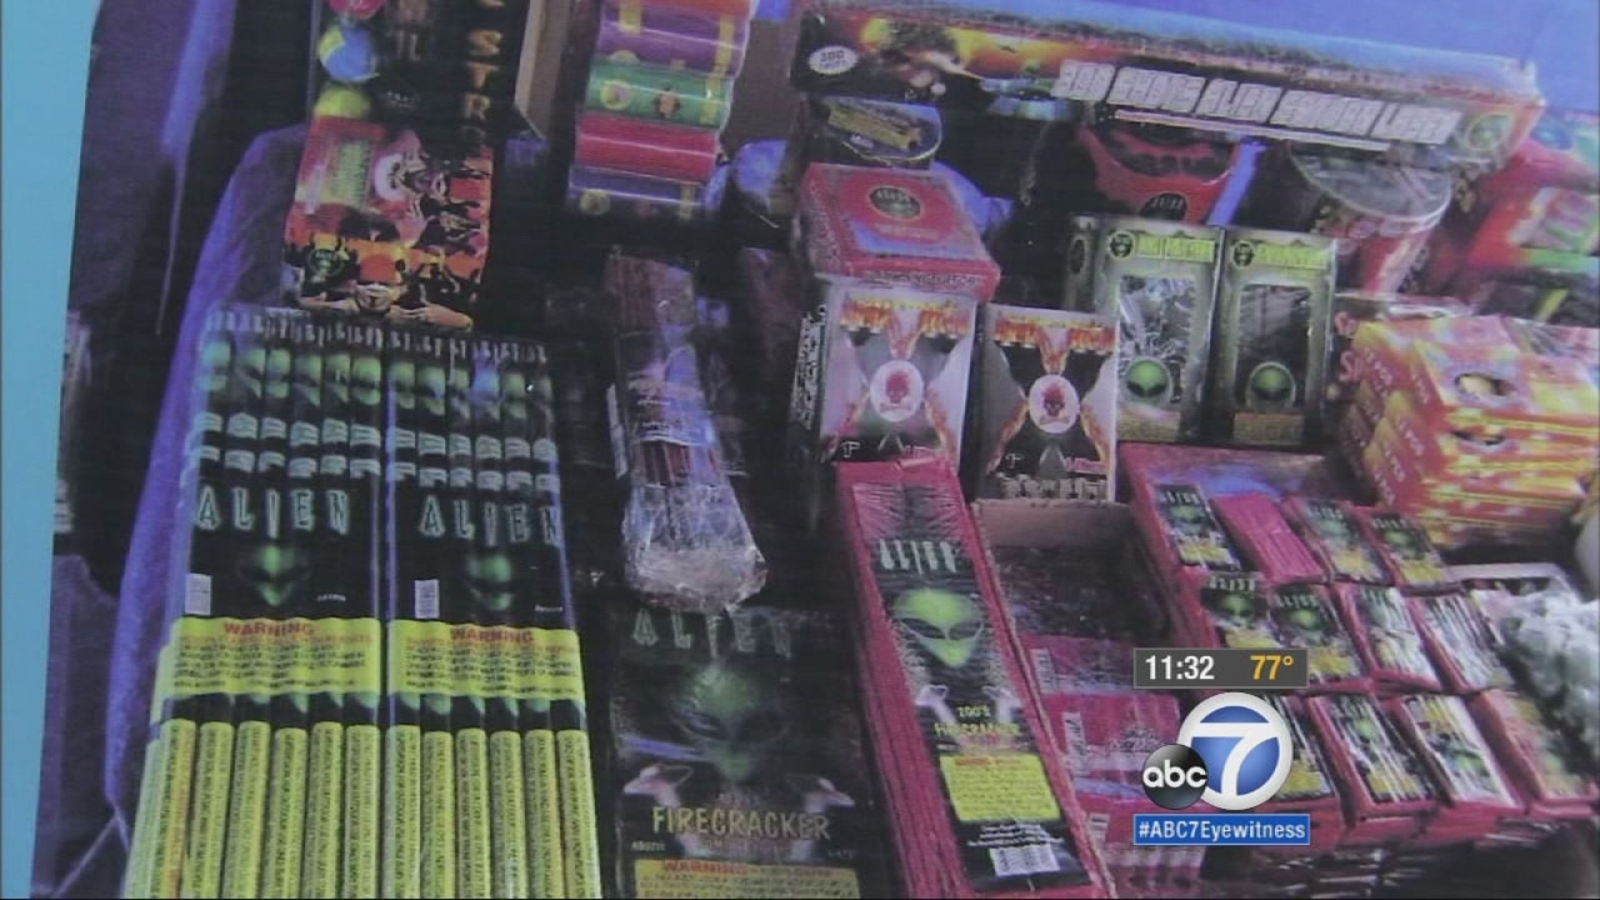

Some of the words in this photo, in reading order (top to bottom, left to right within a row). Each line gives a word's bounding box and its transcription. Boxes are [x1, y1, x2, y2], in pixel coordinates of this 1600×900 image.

[195, 486, 349, 539] ALIEN
[418, 495, 560, 549] ALIEN
[224, 621, 316, 637] WARNING
[452, 628, 534, 643] WARNING
[652, 806, 831, 841] FIRECRACKER
[664, 859, 748, 875] WARNING
